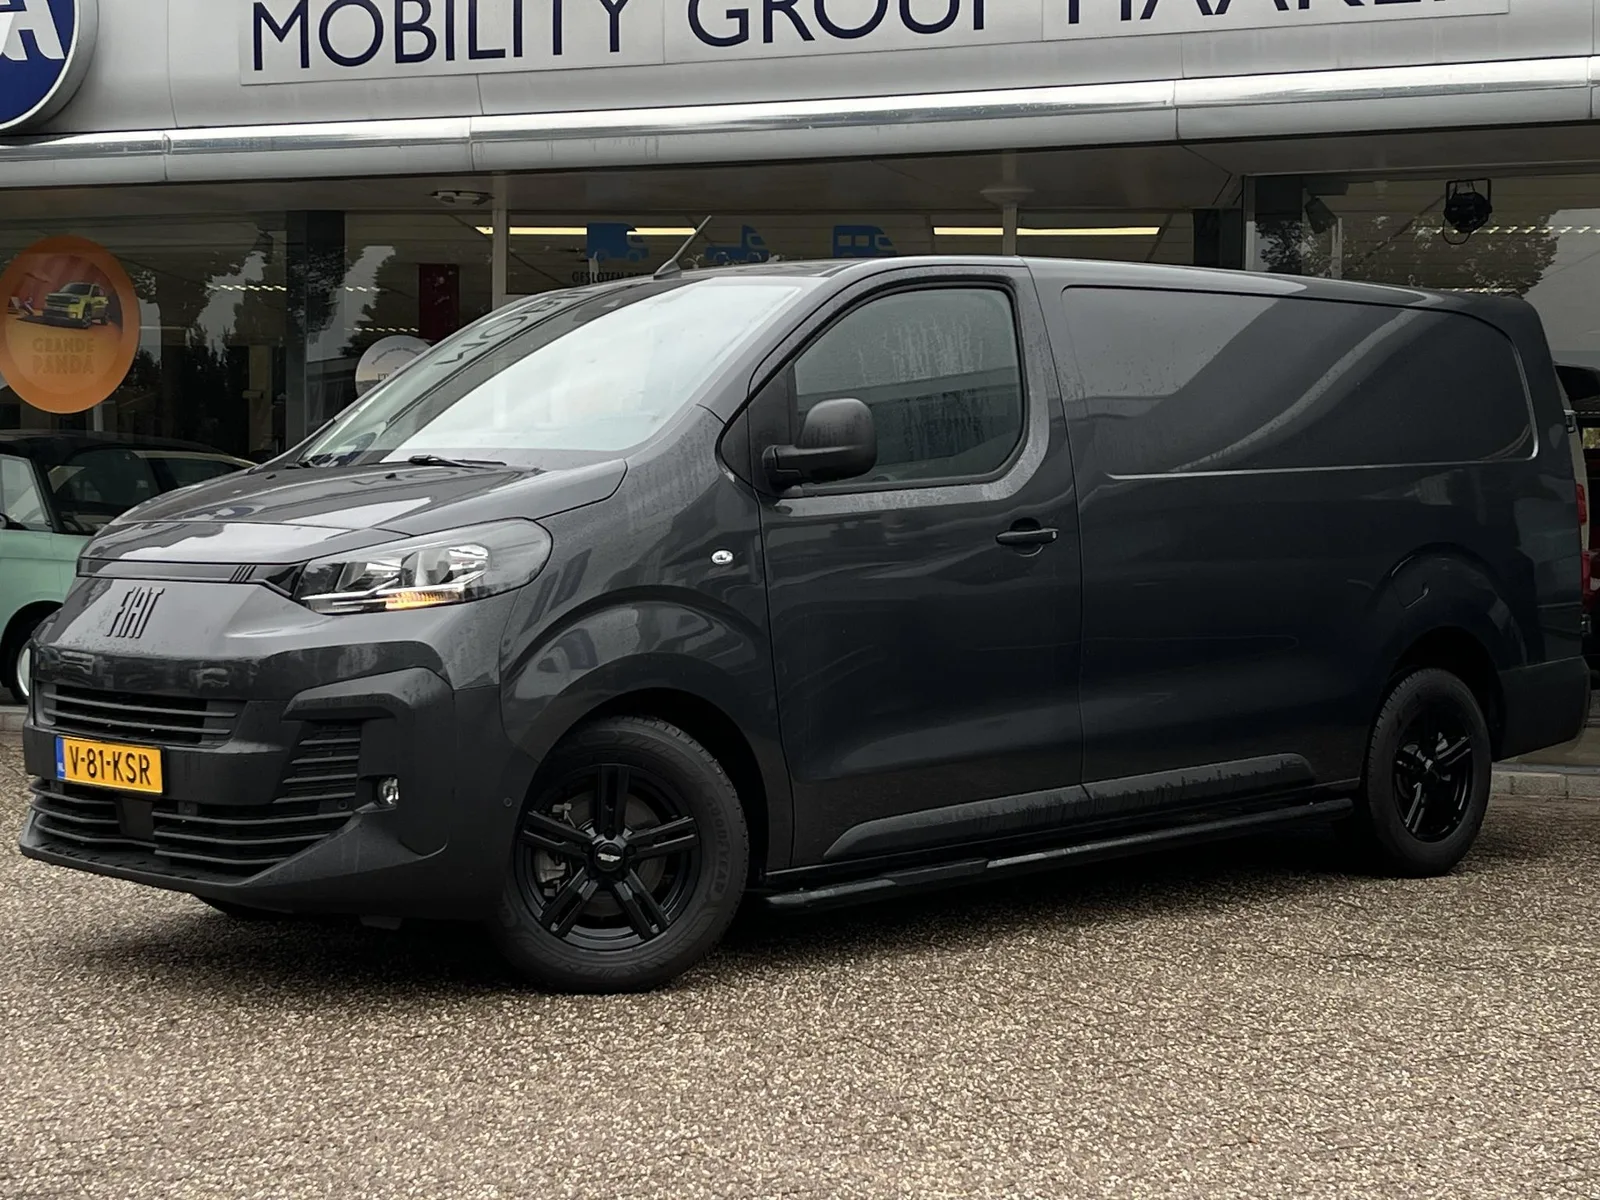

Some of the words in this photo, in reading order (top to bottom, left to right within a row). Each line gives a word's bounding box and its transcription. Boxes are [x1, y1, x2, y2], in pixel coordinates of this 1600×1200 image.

[32, 337, 95, 353] GRANDE
[32, 355, 95, 374] PANDA
[104, 585, 165, 639] FIAT
[69, 745, 152, 786] V-81-KSR
